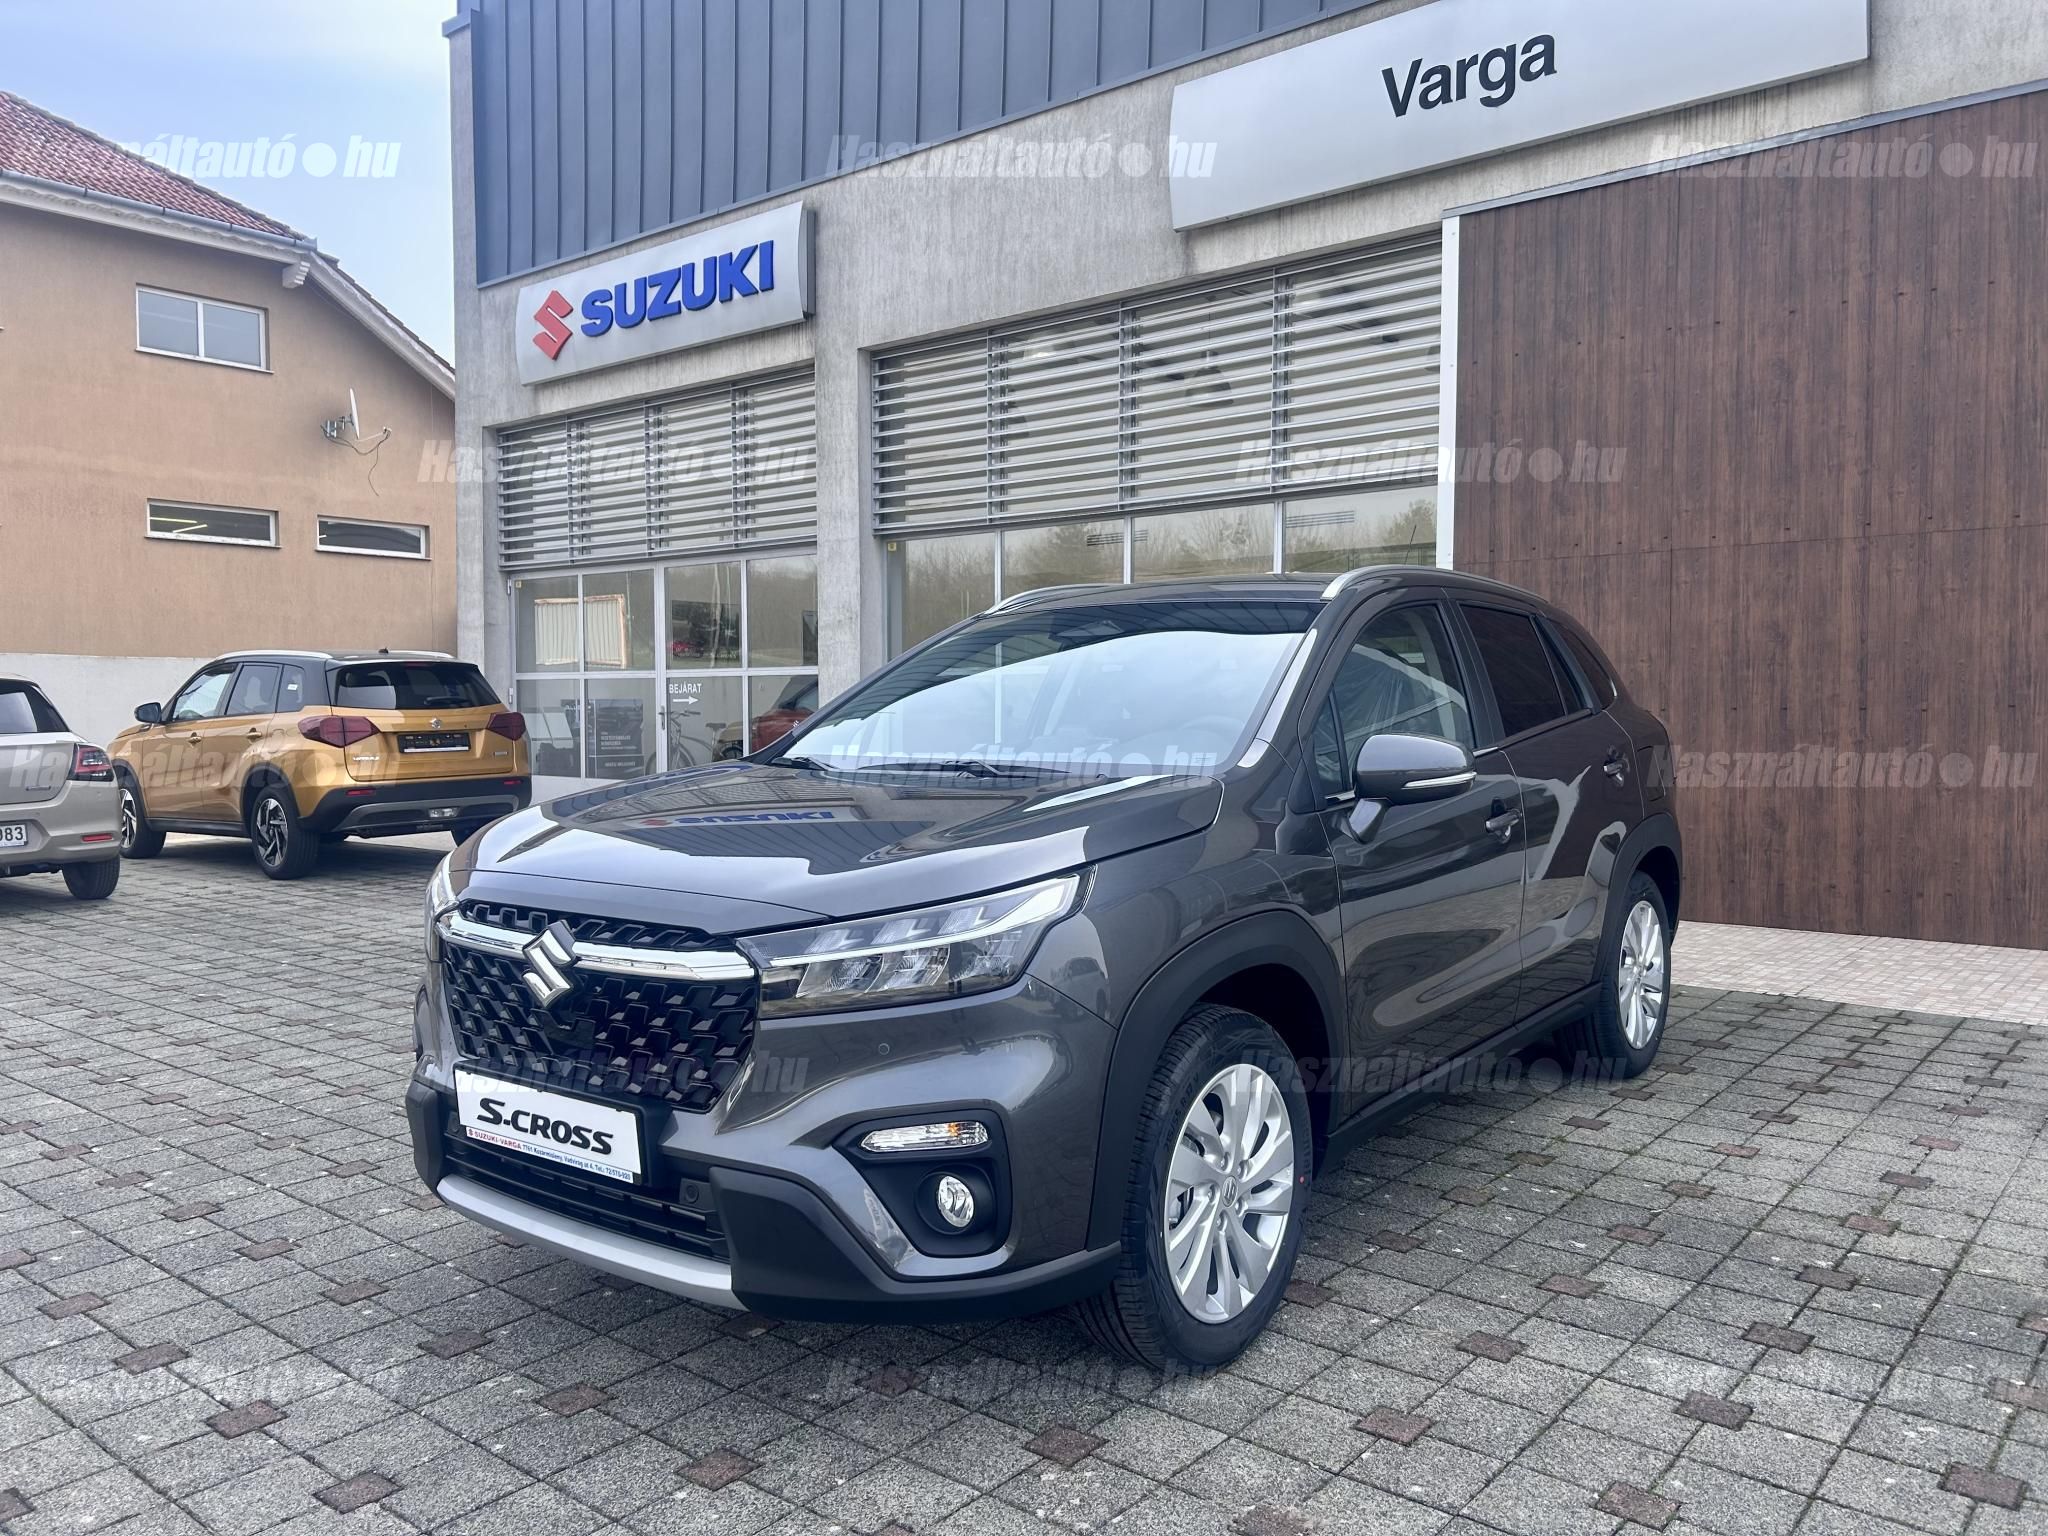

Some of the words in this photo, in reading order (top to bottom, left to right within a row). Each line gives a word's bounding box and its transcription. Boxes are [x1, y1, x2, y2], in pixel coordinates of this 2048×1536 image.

[1381, 33, 1558, 118] Varga
[581, 239, 775, 338] SUZUKI
[669, 683, 702, 694] BEJÁRAT
[0, 826, 24, 842] 83
[474, 1131, 498, 1143] SUZUKI
[499, 1138, 522, 1150] VARGA
